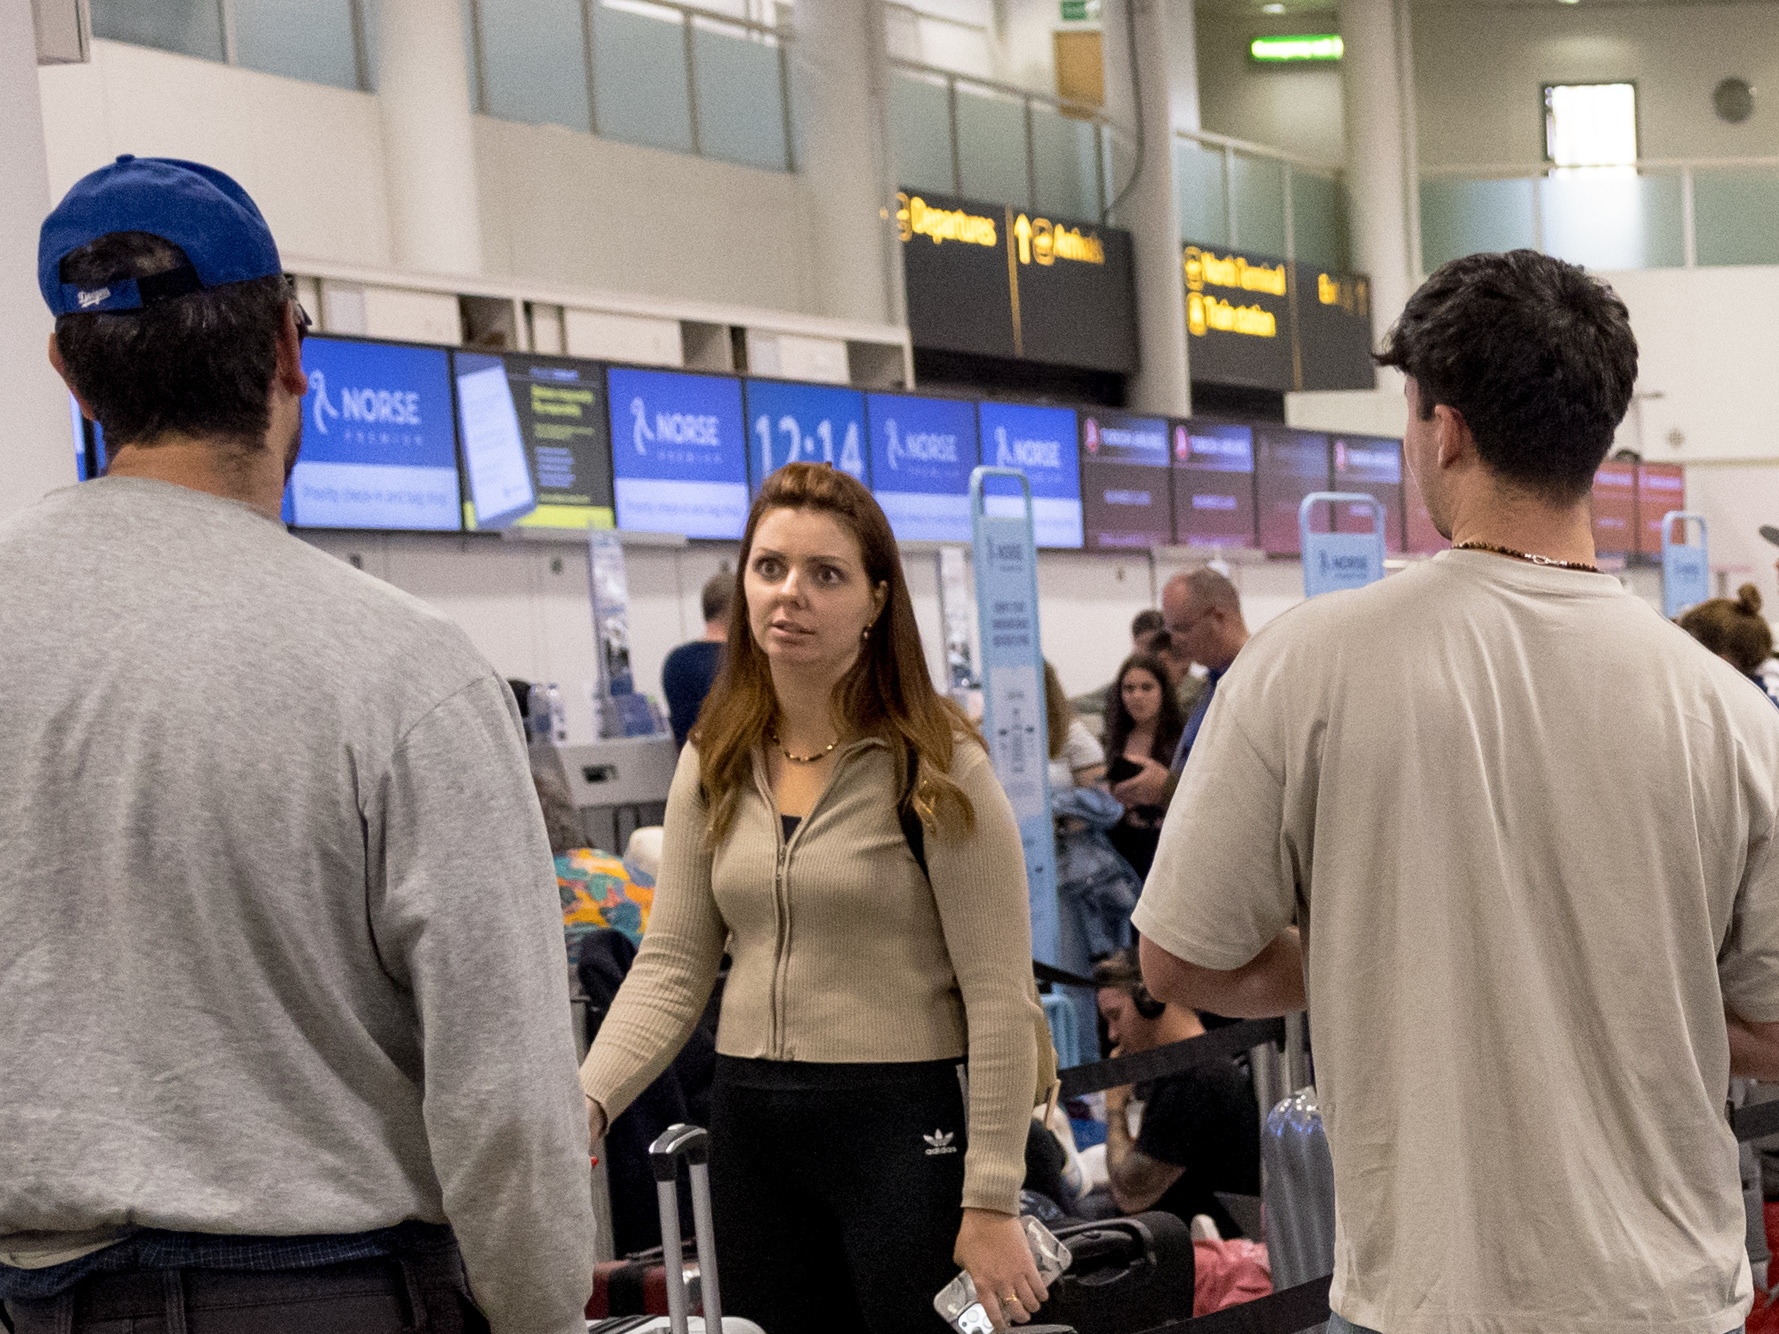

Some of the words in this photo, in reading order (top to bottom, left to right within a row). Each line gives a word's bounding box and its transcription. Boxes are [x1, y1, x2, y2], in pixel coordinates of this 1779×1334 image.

[341, 386, 421, 426] NORSE
[656, 412, 720, 447] NORSE
[925, 1146, 957, 1156] adidas
